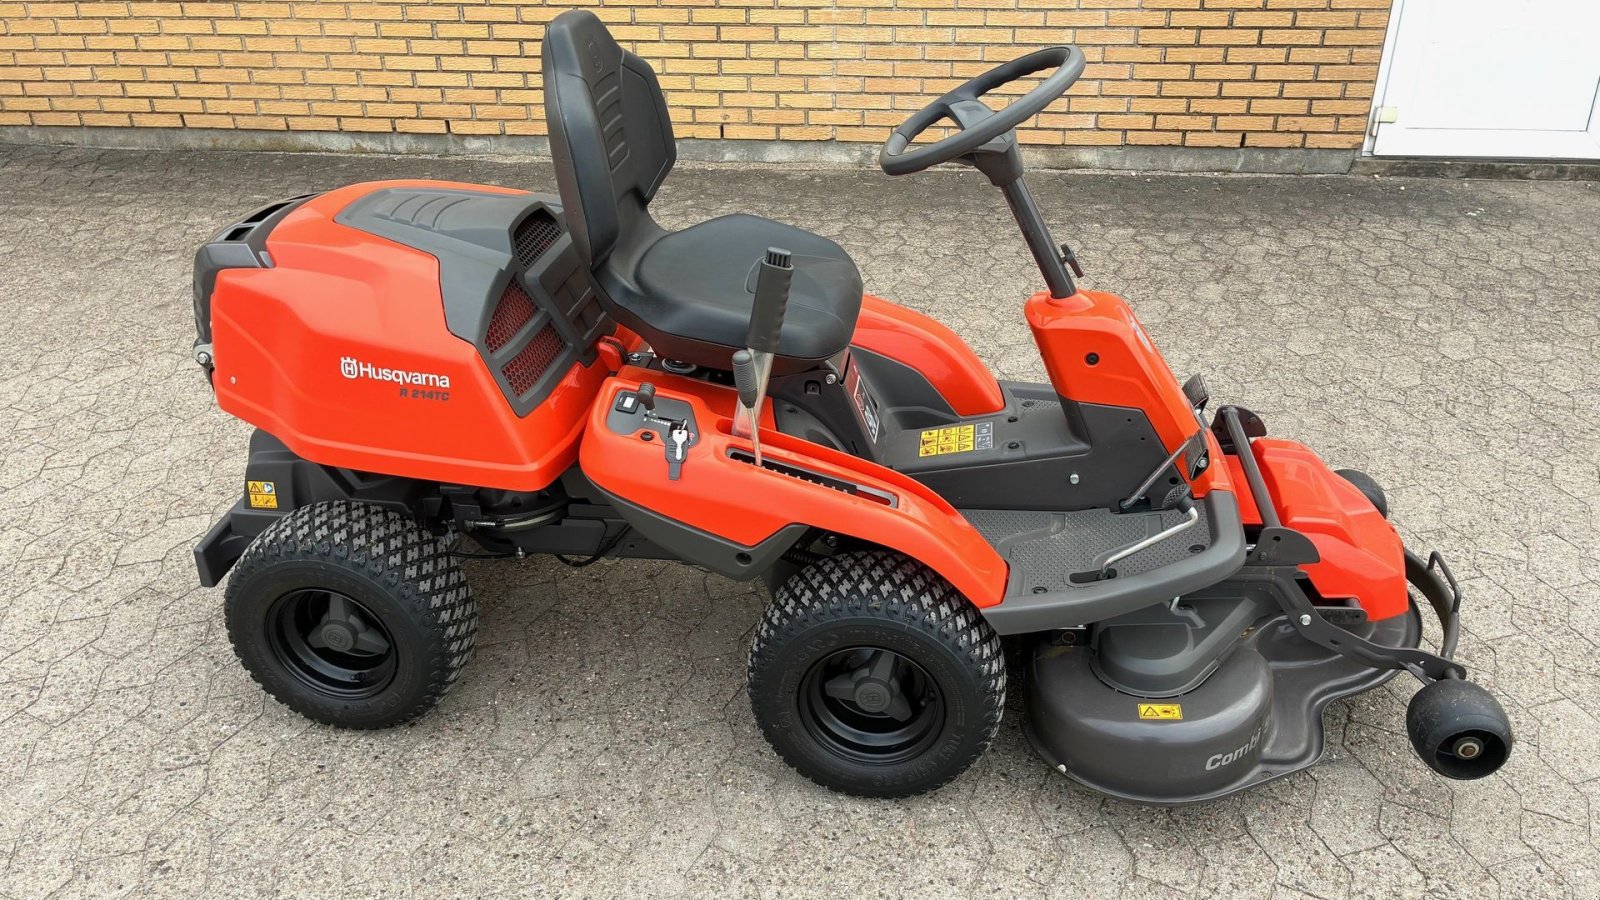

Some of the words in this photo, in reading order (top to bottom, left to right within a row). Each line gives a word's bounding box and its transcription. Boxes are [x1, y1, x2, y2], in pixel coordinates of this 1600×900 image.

[359, 362, 450, 388] Husqvarna
[399, 388, 408, 398] R
[411, 389, 450, 401] 214TC
[1205, 727, 1261, 770] Combi
